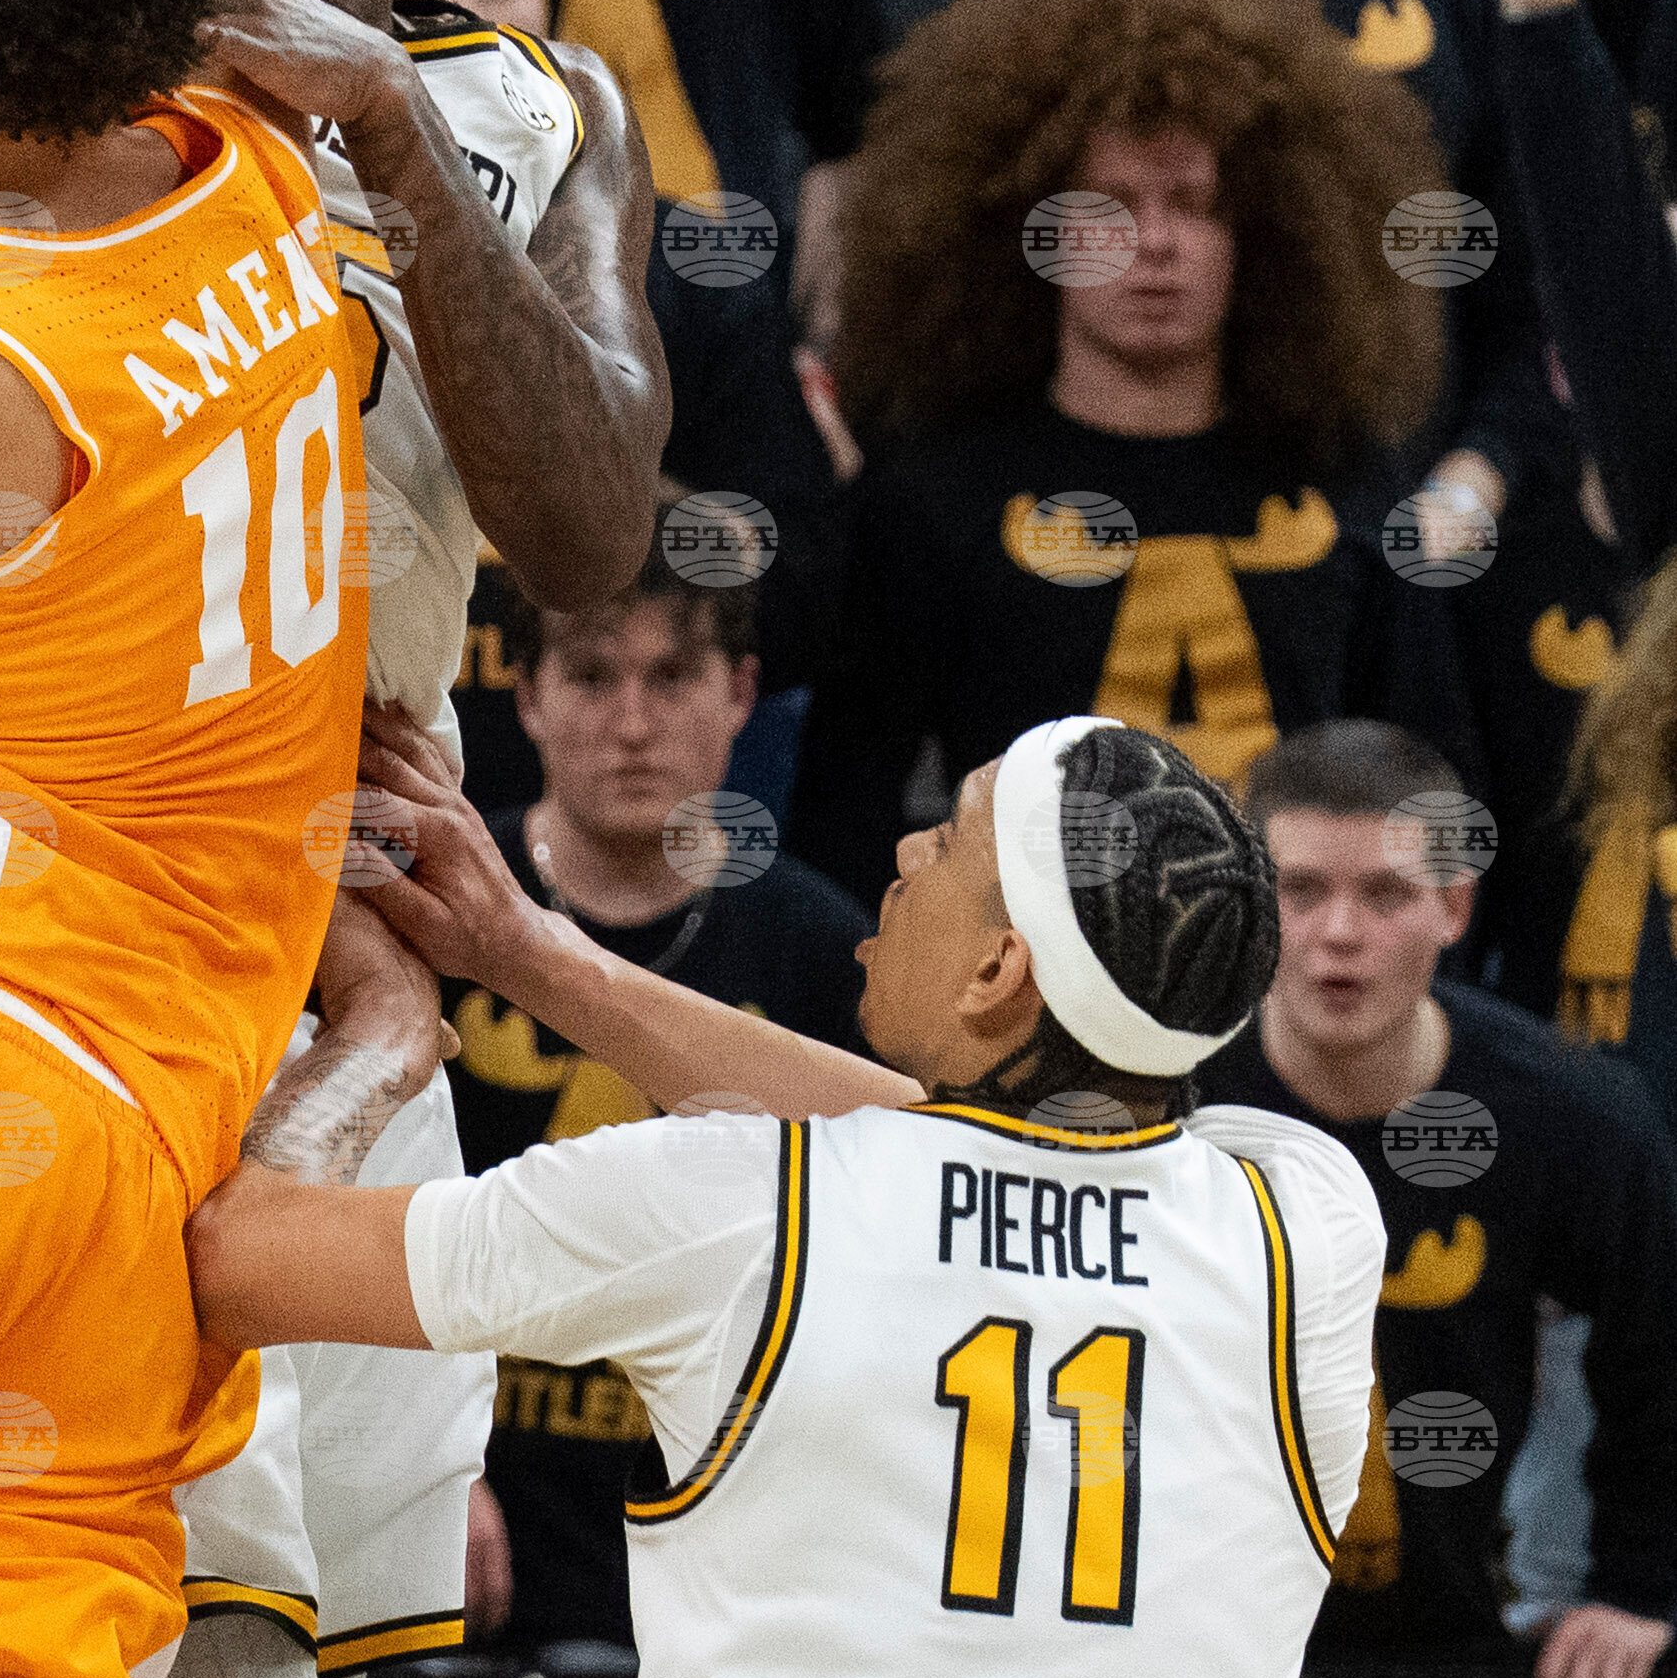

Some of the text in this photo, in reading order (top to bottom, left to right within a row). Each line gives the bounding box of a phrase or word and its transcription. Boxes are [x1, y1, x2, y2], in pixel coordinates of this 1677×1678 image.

[182, 367, 344, 709] 10
[938, 1160, 1149, 1287] PIERCE
[935, 1316, 1147, 1627] 11
